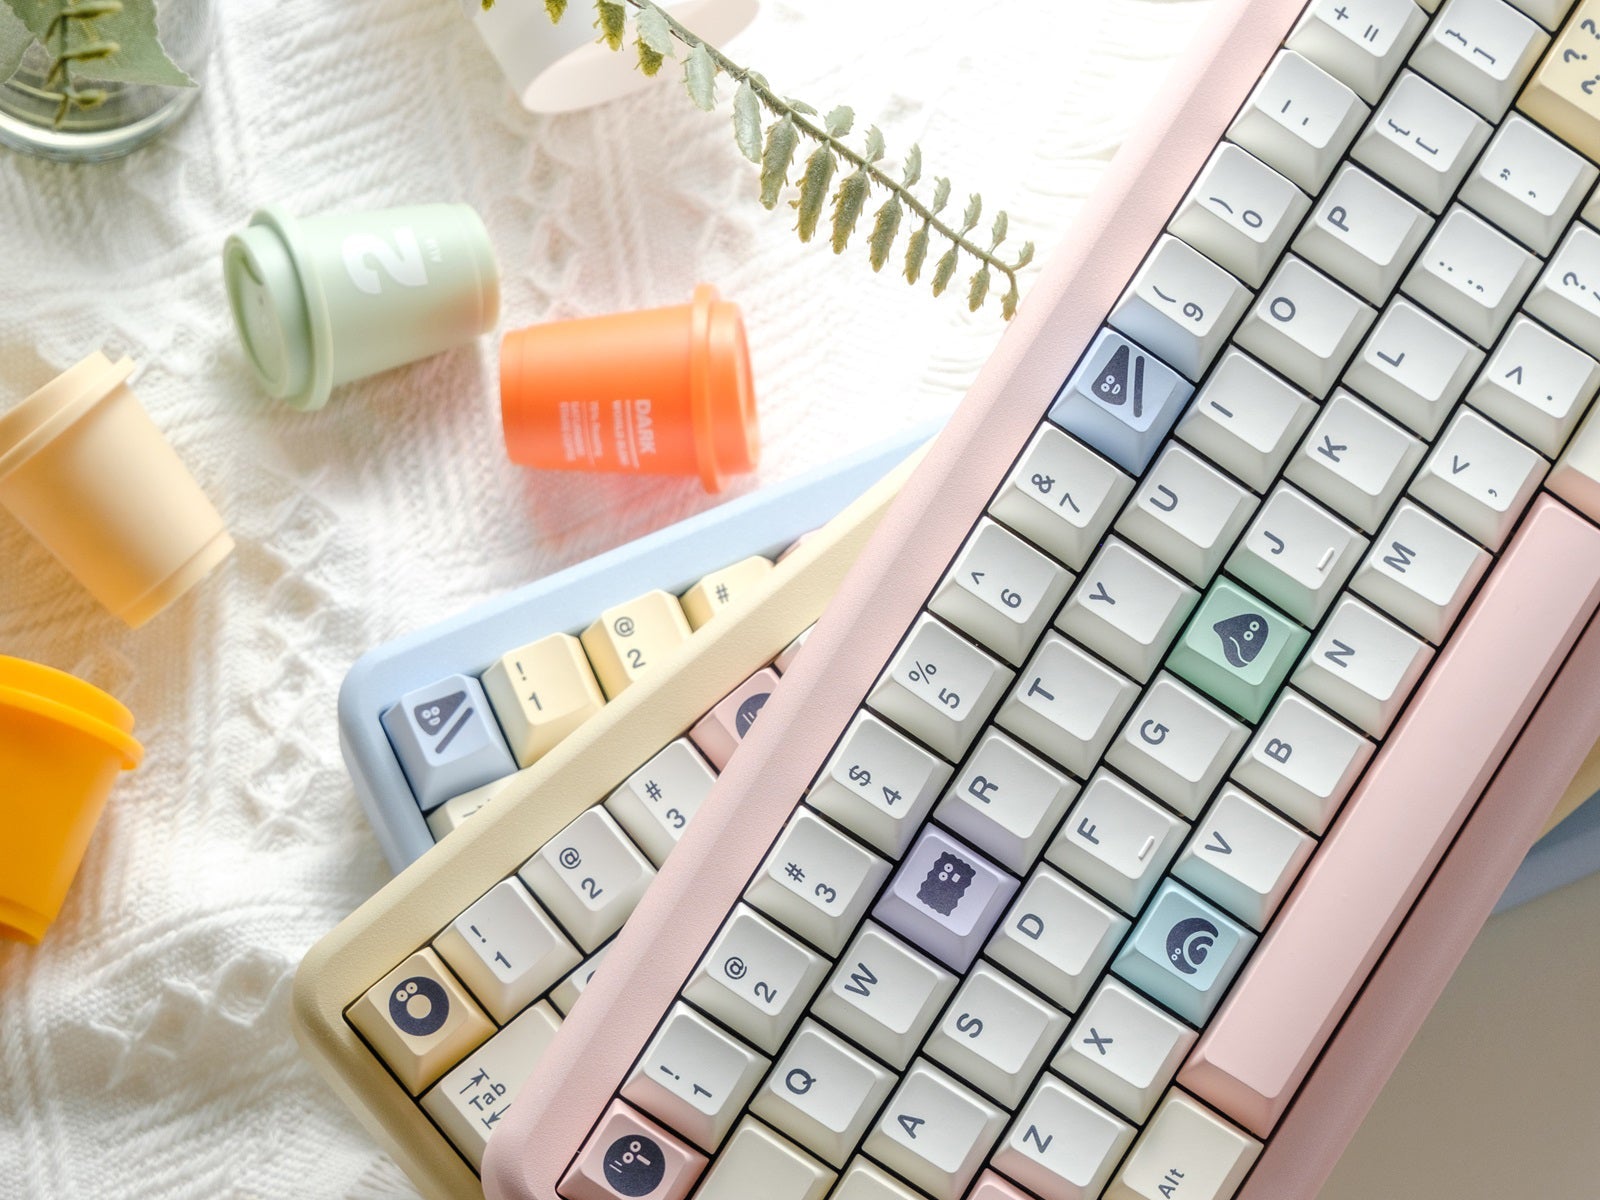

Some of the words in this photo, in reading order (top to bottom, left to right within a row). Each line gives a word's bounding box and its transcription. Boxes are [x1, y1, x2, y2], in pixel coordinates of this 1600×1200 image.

[1243, 210, 1262, 228] 0
[1327, 206, 1349, 232] P
[342, 225, 429, 294] 2
[1183, 302, 1203, 321] 9
[1270, 297, 1296, 322] O
[1377, 351, 1405, 367] L
[1211, 401, 1233, 418] I
[632, 399, 656, 455] DARK
[1317, 435, 1347, 462] K
[1059, 493, 1080, 513] 7
[1149, 485, 1179, 513] U
[1264, 531, 1284, 554] J
[1383, 541, 1416, 573] M
[1001, 589, 1021, 608] 6
[1089, 582, 1115, 605] Y
[627, 649, 646, 669] 2
[1325, 639, 1355, 668] N
[938, 687, 960, 710] 5
[1028, 677, 1054, 700] T
[529, 692, 542, 710] 1
[1140, 720, 1169, 745] G
[1264, 738, 1292, 763] B
[883, 786, 901, 805] 4
[968, 776, 998, 803] R
[666, 808, 685, 828] 3
[1077, 818, 1099, 844] F
[1205, 831, 1232, 854] V
[581, 878, 603, 899] 2
[815, 883, 836, 903] 3
[1017, 914, 1044, 940] D
[495, 951, 511, 968] 1
[844, 963, 878, 996] W
[754, 982, 777, 1003] 2
[956, 1013, 983, 1038] S
[1083, 1027, 1113, 1056] X
[693, 1084, 712, 1098] 1
[786, 1069, 816, 1094] Q
[468, 1083, 507, 1111] Tab
[898, 1115, 925, 1139] A
[1023, 1125, 1053, 1153] Z
[1158, 1169, 1184, 1199] Alt
